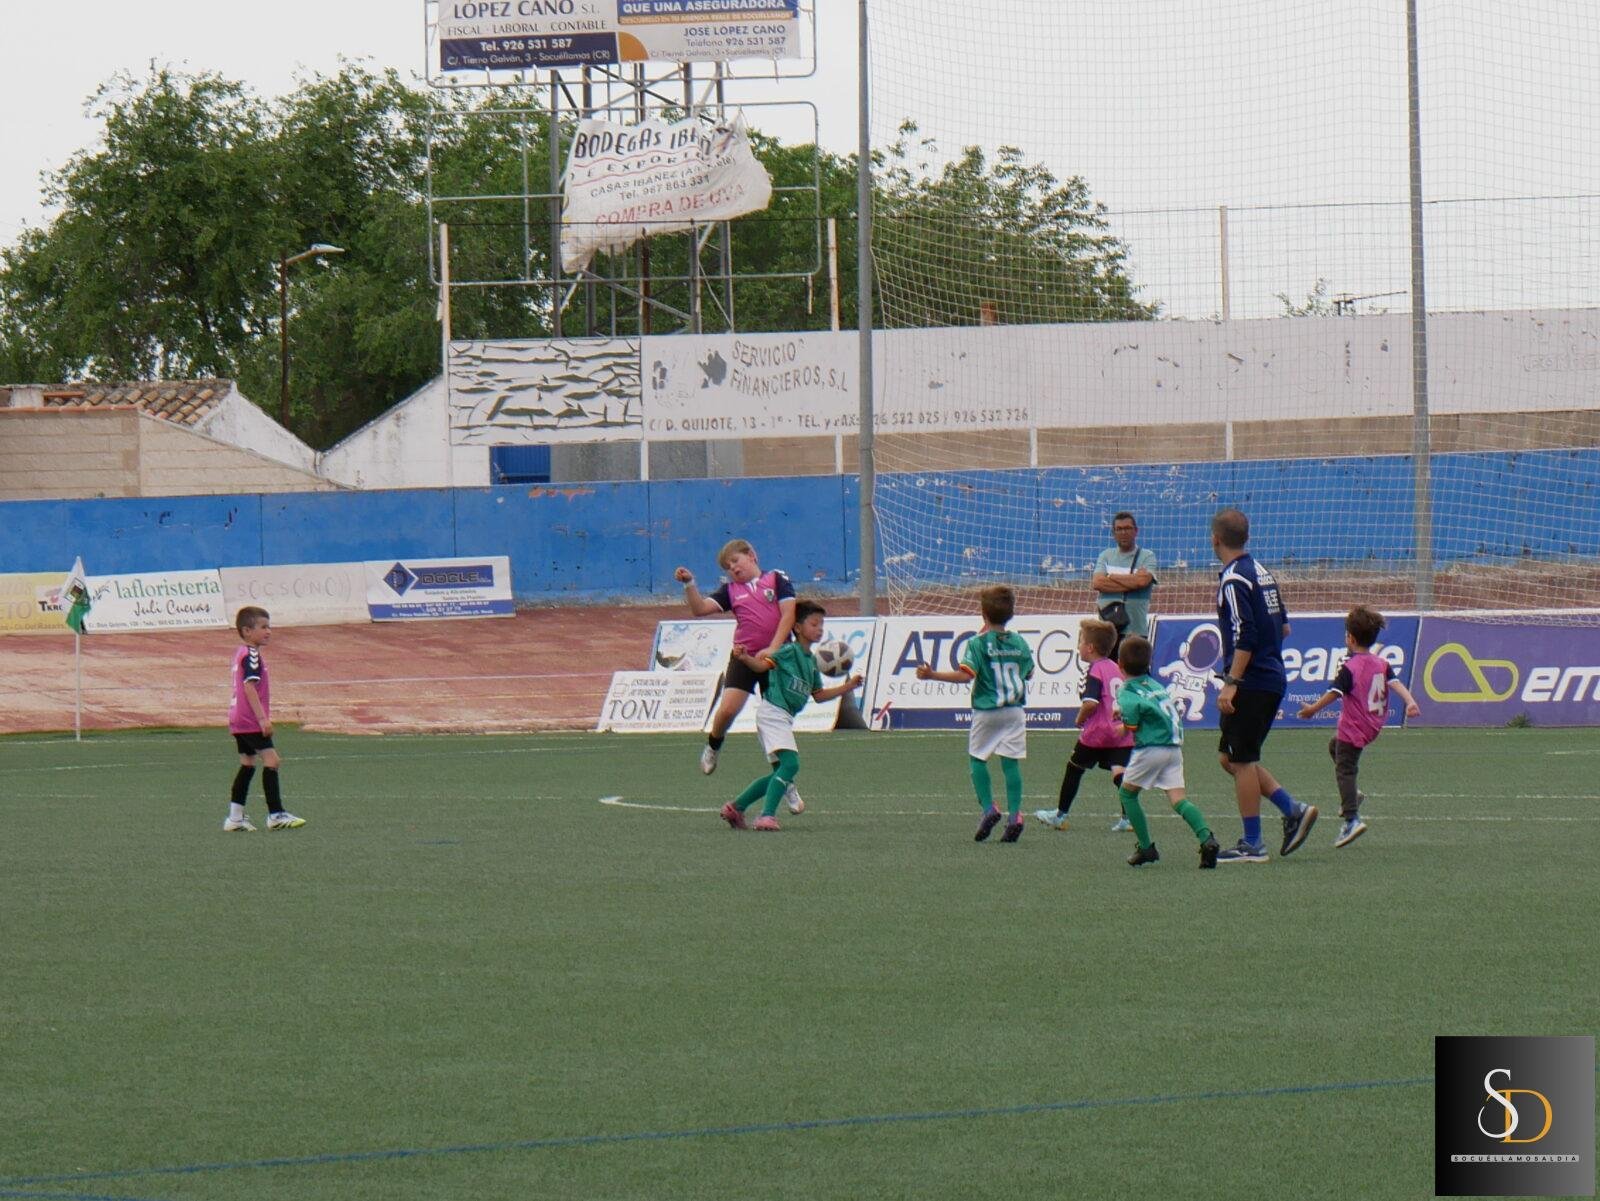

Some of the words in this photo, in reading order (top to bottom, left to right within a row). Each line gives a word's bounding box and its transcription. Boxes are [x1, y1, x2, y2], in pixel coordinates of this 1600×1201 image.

[518, 0, 574, 16] CANO
[622, 3, 651, 14] QUE
[654, 2, 683, 12] UNA
[685, 0, 786, 12] ASEGURADORA
[448, 25, 482, 36] FISCAL
[493, 22, 540, 33] LABORAL
[550, 20, 608, 32] CONTABLE
[752, 24, 786, 35] CANO
[480, 42, 500, 52] Tel.
[503, 40, 525, 50] 926
[528, 39, 548, 49] 531
[552, 38, 573, 48] 587
[725, 37, 745, 47] 926
[747, 37, 764, 46] 531
[768, 36, 787, 46] 587
[462, 54, 489, 65] Tierno
[524, 53, 532, 62] 3
[592, 50, 611, 60] (CR)
[574, 127, 662, 159] BODEGAS
[590, 180, 631, 198] CASAS
[595, 201, 674, 228] COMPRA
[114, 575, 221, 600] lafloristería
[990, 661, 1024, 708] 10
[1367, 672, 1388, 718] 4
[608, 698, 662, 720] TONI
